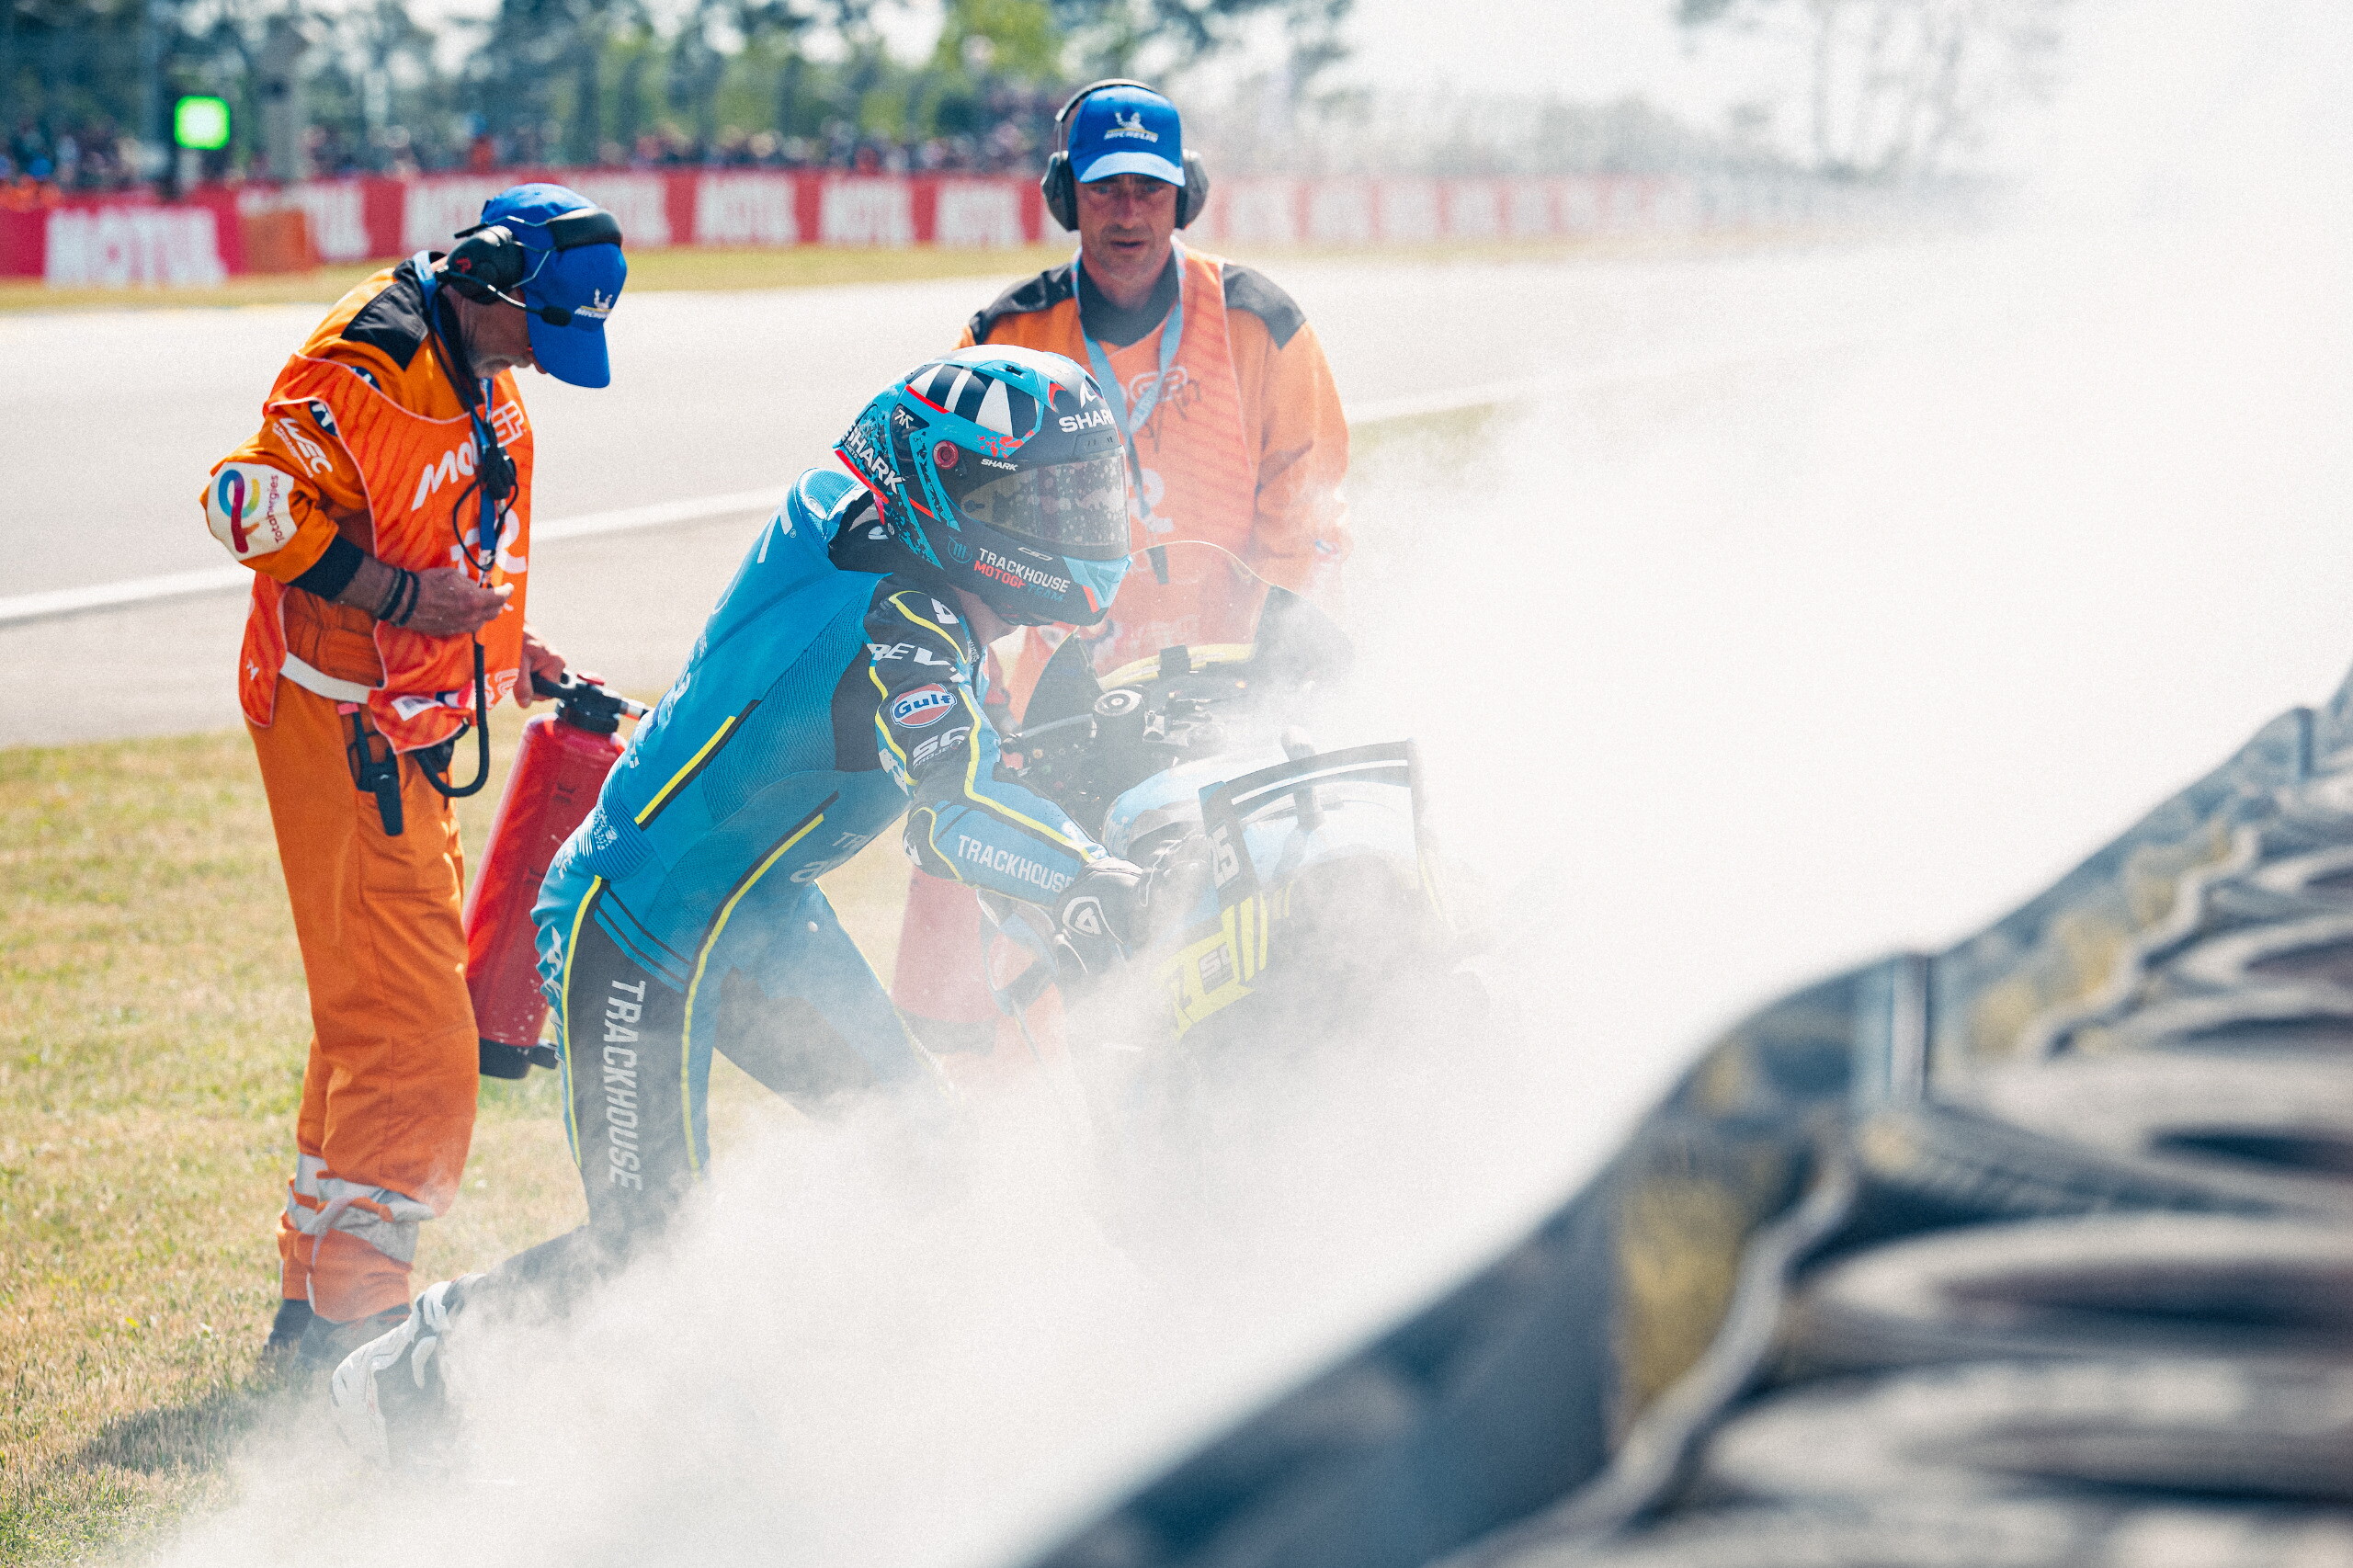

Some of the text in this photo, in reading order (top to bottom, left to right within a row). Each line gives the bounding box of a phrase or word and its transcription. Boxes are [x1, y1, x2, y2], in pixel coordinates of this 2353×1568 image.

[1104, 131, 1158, 143] MICHELIN
[278, 417, 334, 475] WEC
[981, 458, 1019, 472] SHARK
[979, 547, 1071, 594] TRACKHOUSE
[894, 694, 951, 719] Gulf
[603, 980, 647, 1192] TRACKHOUSE
